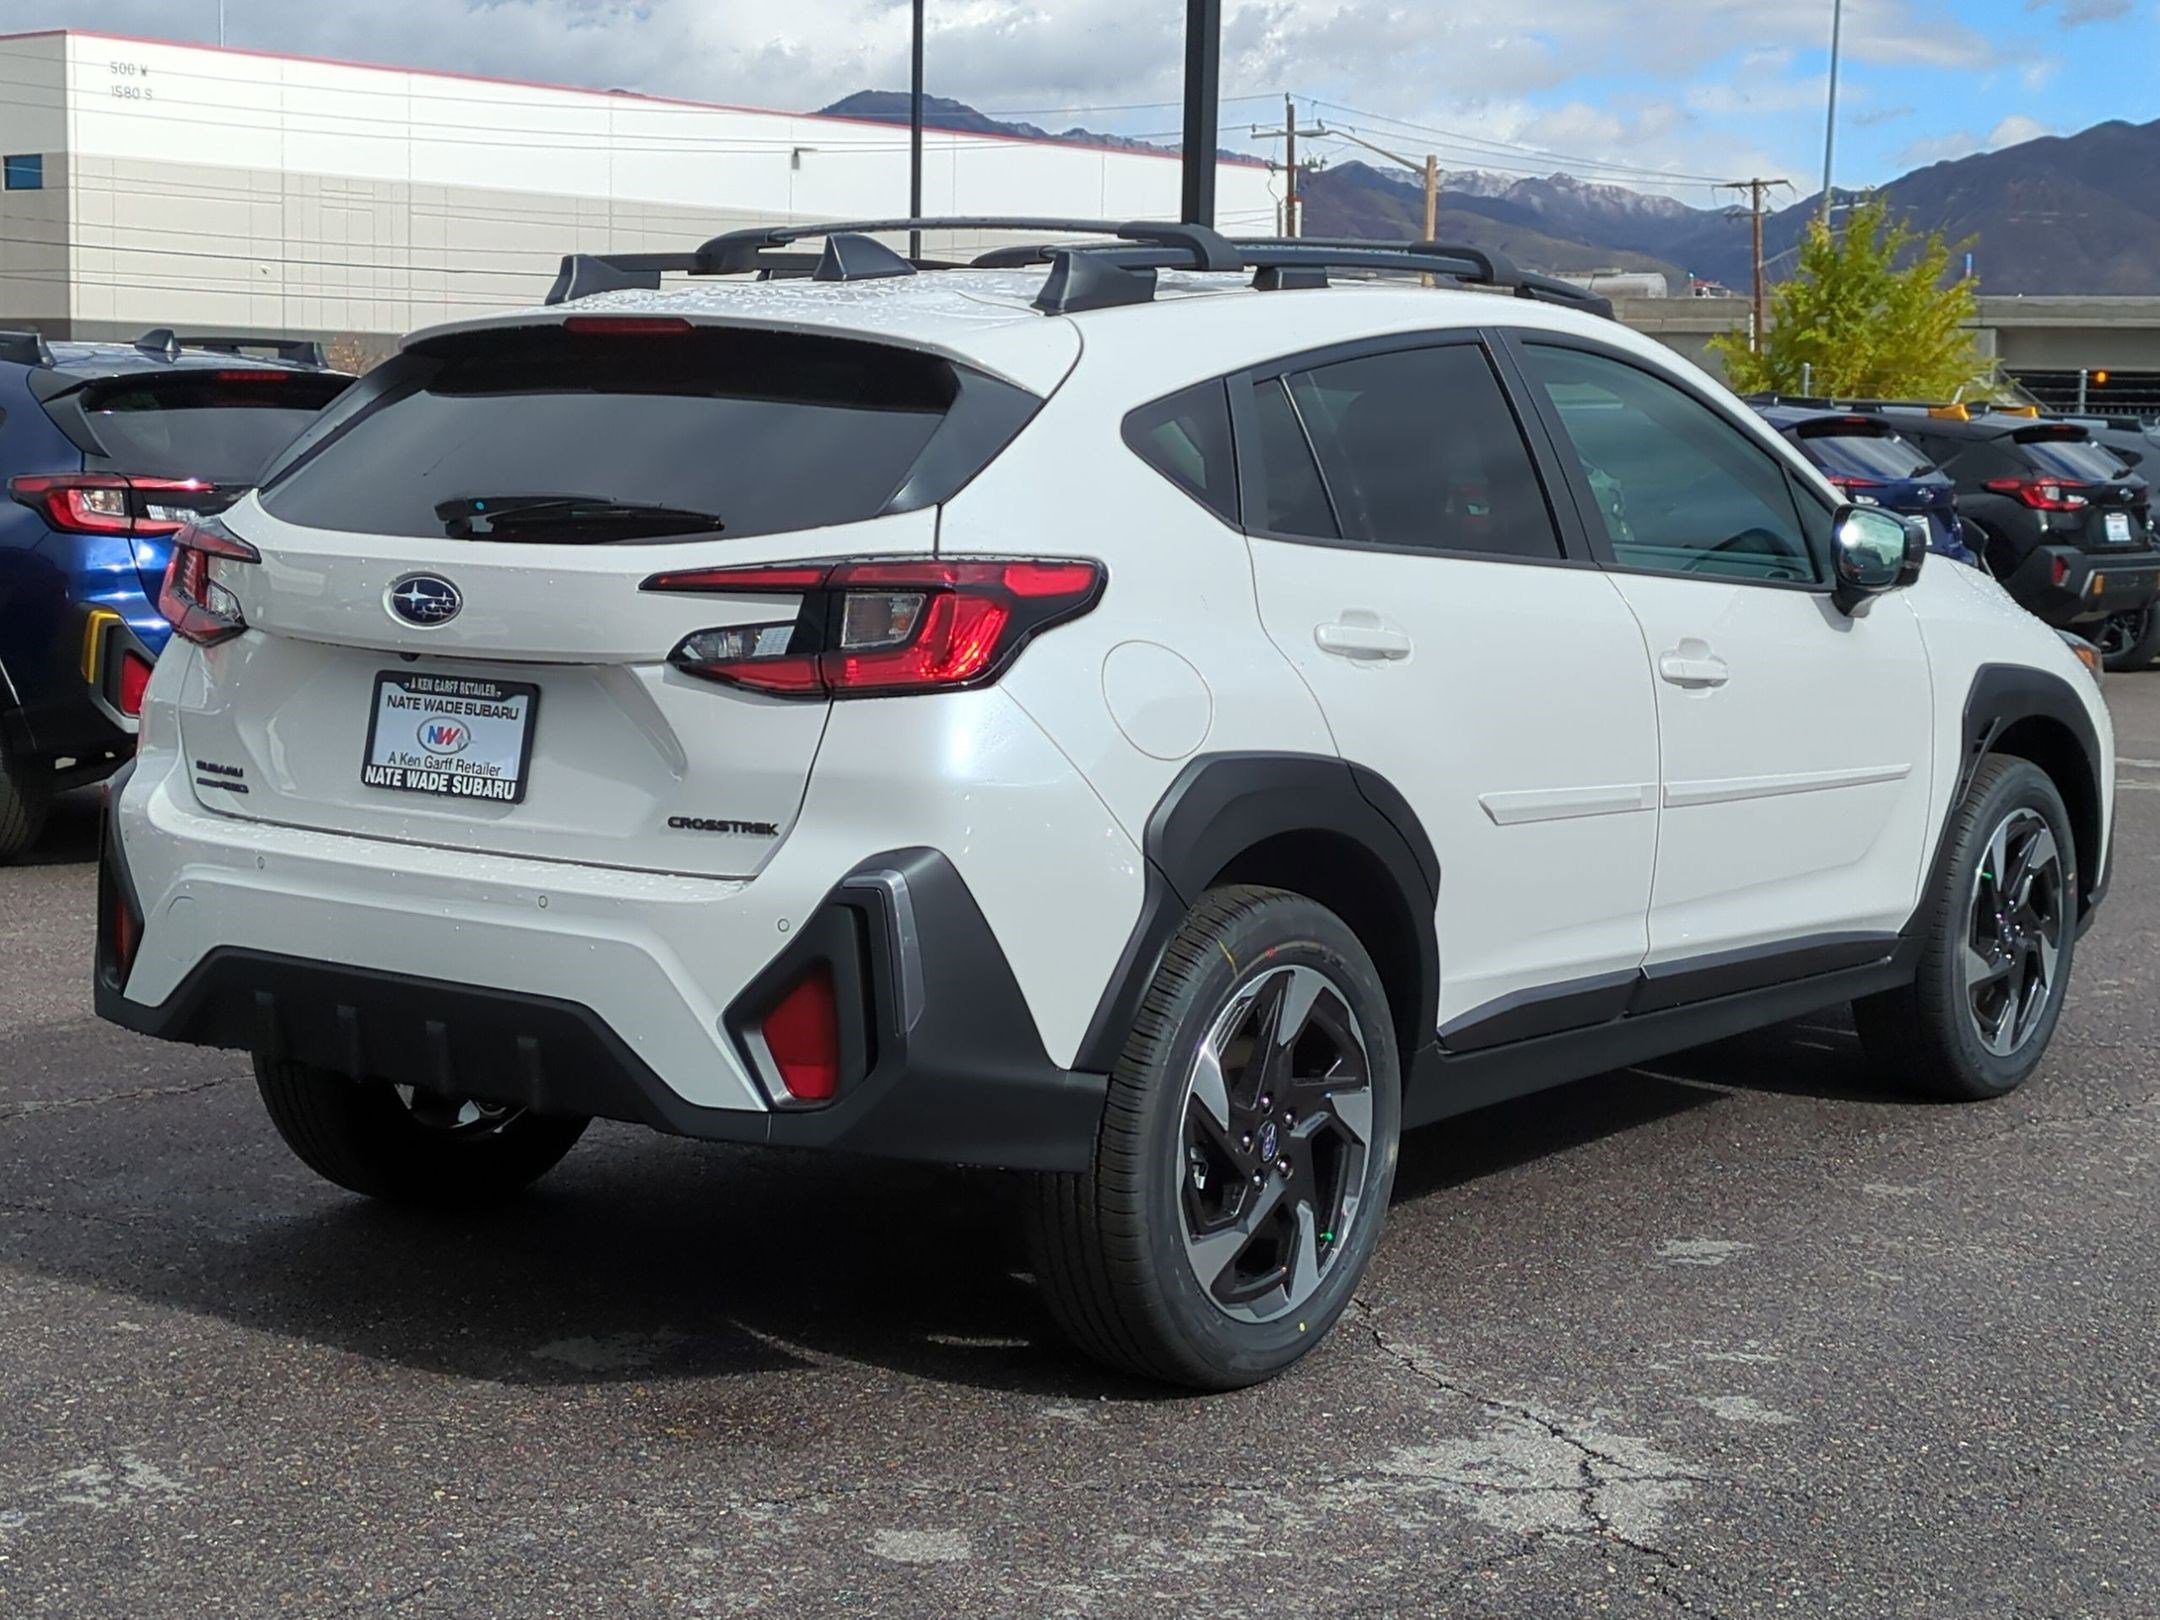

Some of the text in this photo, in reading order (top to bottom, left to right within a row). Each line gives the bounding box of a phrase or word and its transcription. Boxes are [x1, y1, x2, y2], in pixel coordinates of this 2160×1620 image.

[110, 61, 135, 76] 500
[111, 85, 153, 101] 1580 S
[418, 679, 432, 691] KEN
[435, 680, 458, 693] GARFF
[460, 682, 496, 698] RETAILER
[387, 695, 519, 720] NATE WADE SUBARU
[427, 726, 460, 745] NW
[388, 751, 502, 777] A Ken Garff Retailer
[365, 765, 516, 800] NATE WADE SUBARU
[667, 816, 779, 836] CROSSTREK
